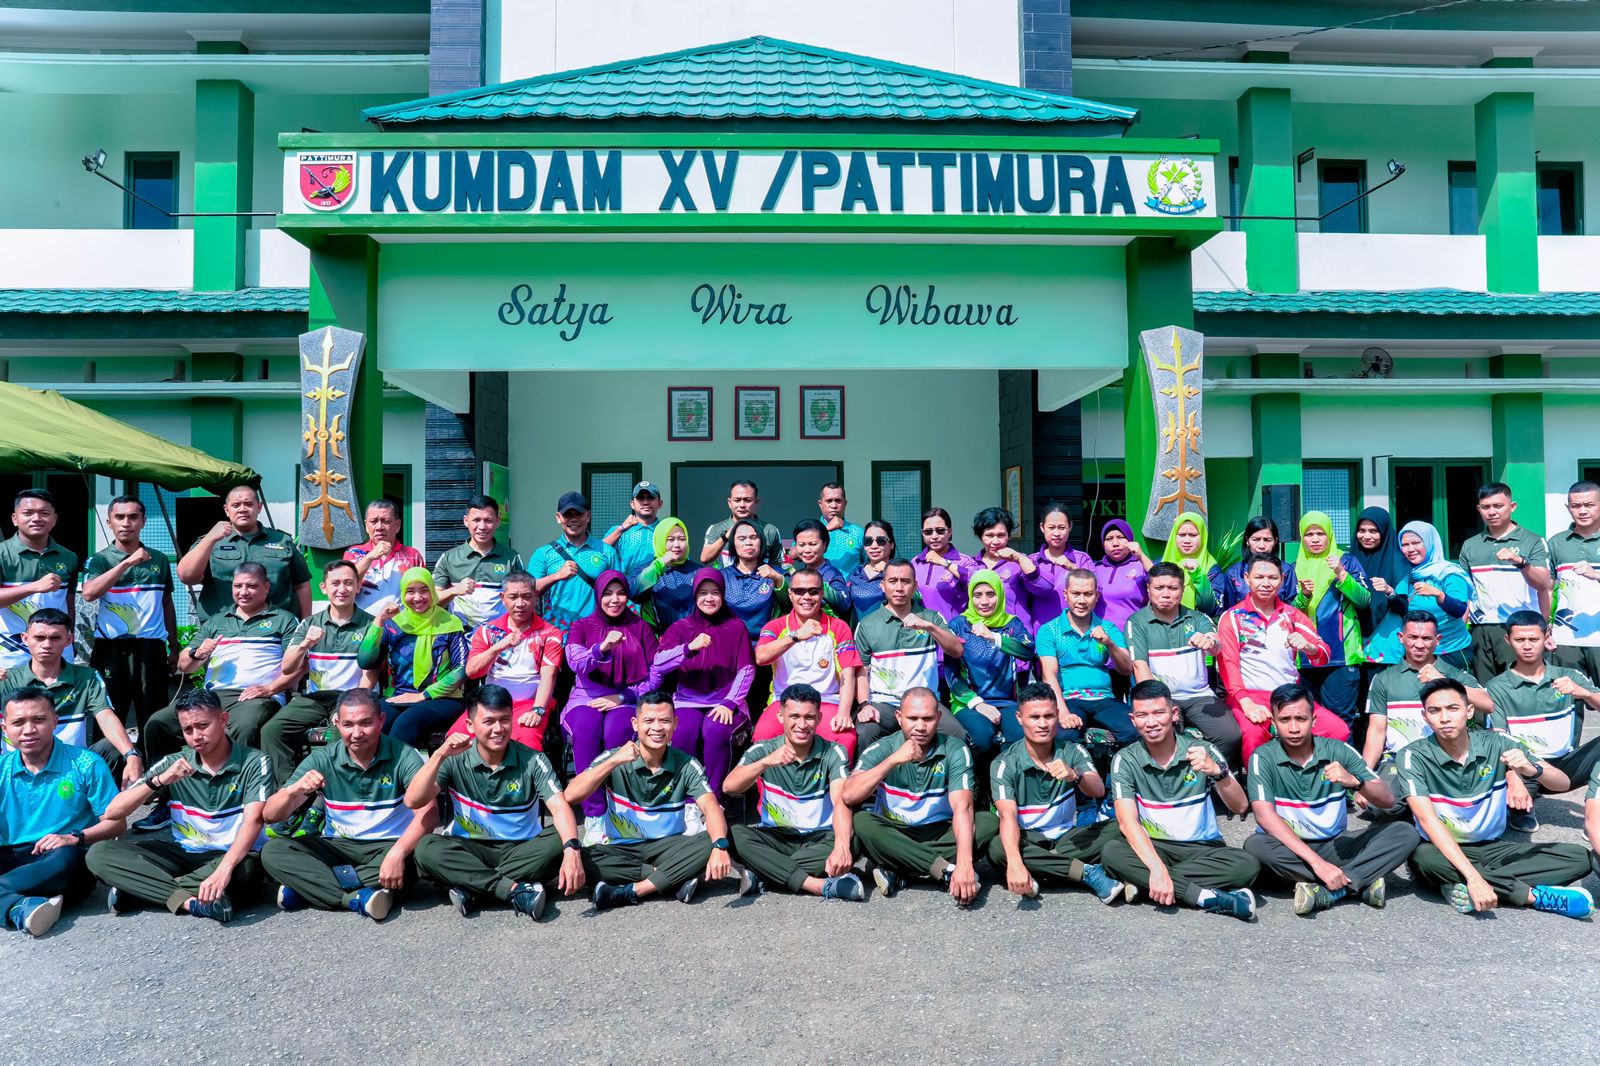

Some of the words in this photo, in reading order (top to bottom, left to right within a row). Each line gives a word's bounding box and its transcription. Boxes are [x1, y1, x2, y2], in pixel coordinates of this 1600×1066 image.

[370, 151, 622, 212] KUMDAM
[658, 150, 739, 211] XV
[498, 283, 614, 342] Satya
[691, 283, 793, 325] Wira
[866, 283, 1019, 326] Wibawa
